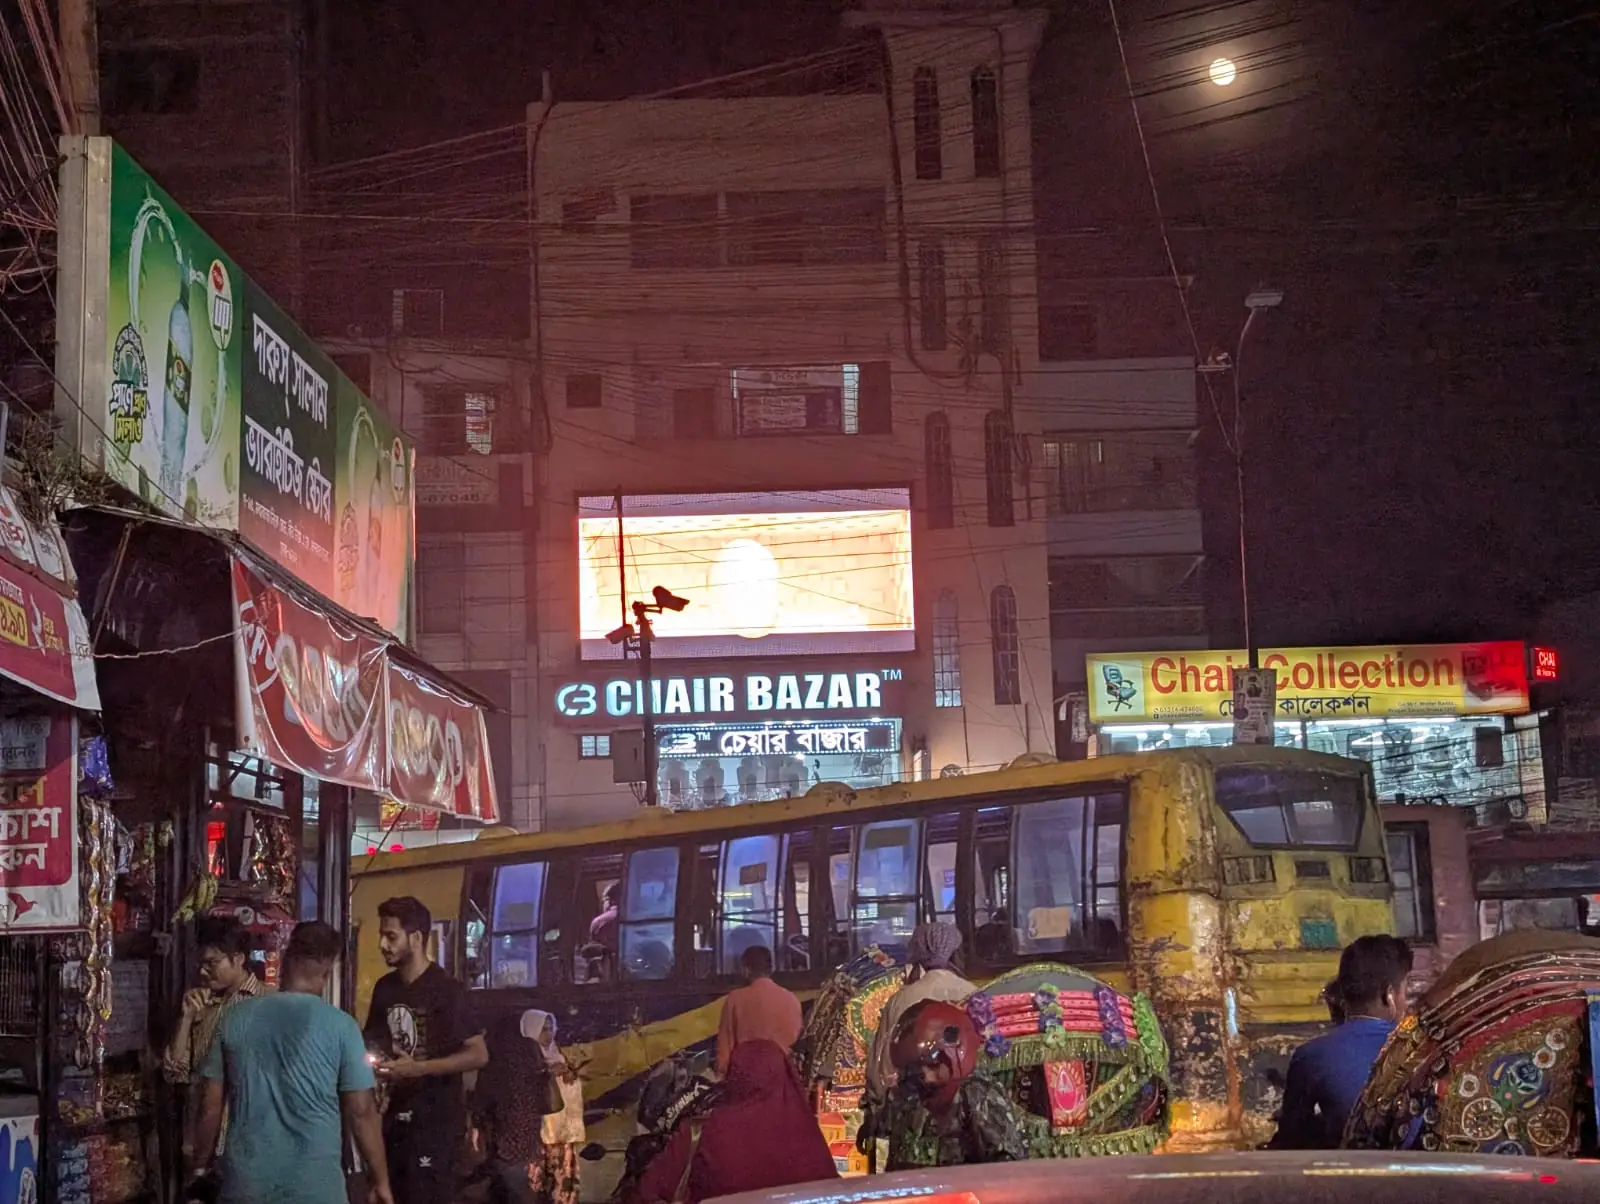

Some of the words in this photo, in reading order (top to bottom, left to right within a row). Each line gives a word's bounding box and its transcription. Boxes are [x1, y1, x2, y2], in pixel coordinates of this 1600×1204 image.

[291, 350, 329, 430] সালাম
[1151, 655, 1250, 694] Chai
[1263, 651, 1454, 691] Collection
[606, 678, 735, 716] CHAIR
[720, 727, 790, 755] চেয়ার
[795, 725, 869, 753] বাজার
